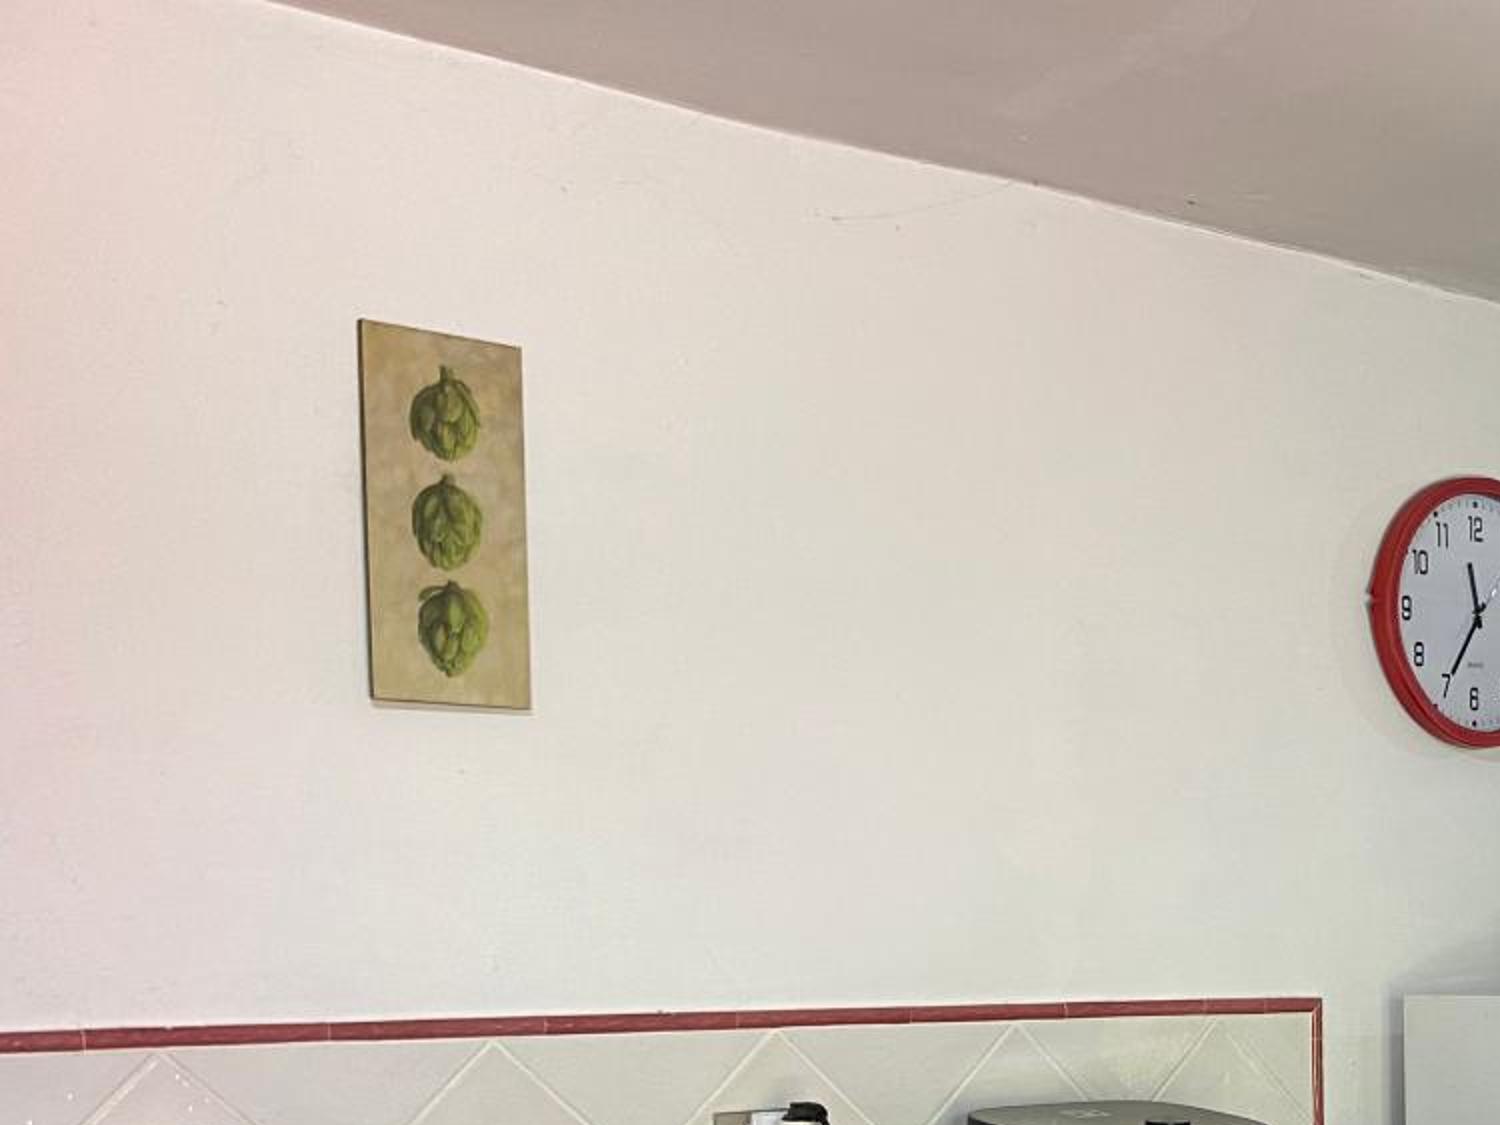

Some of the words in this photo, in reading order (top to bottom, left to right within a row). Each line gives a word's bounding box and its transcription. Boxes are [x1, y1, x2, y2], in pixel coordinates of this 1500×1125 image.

[1436, 522, 1449, 549] 11
[1468, 516, 1484, 542] 12
[1412, 550, 1429, 575] 10
[1401, 596, 1412, 620] 9
[1414, 642, 1424, 666] 8
[1442, 674, 1452, 698] 7
[1469, 688, 1479, 710] 6
